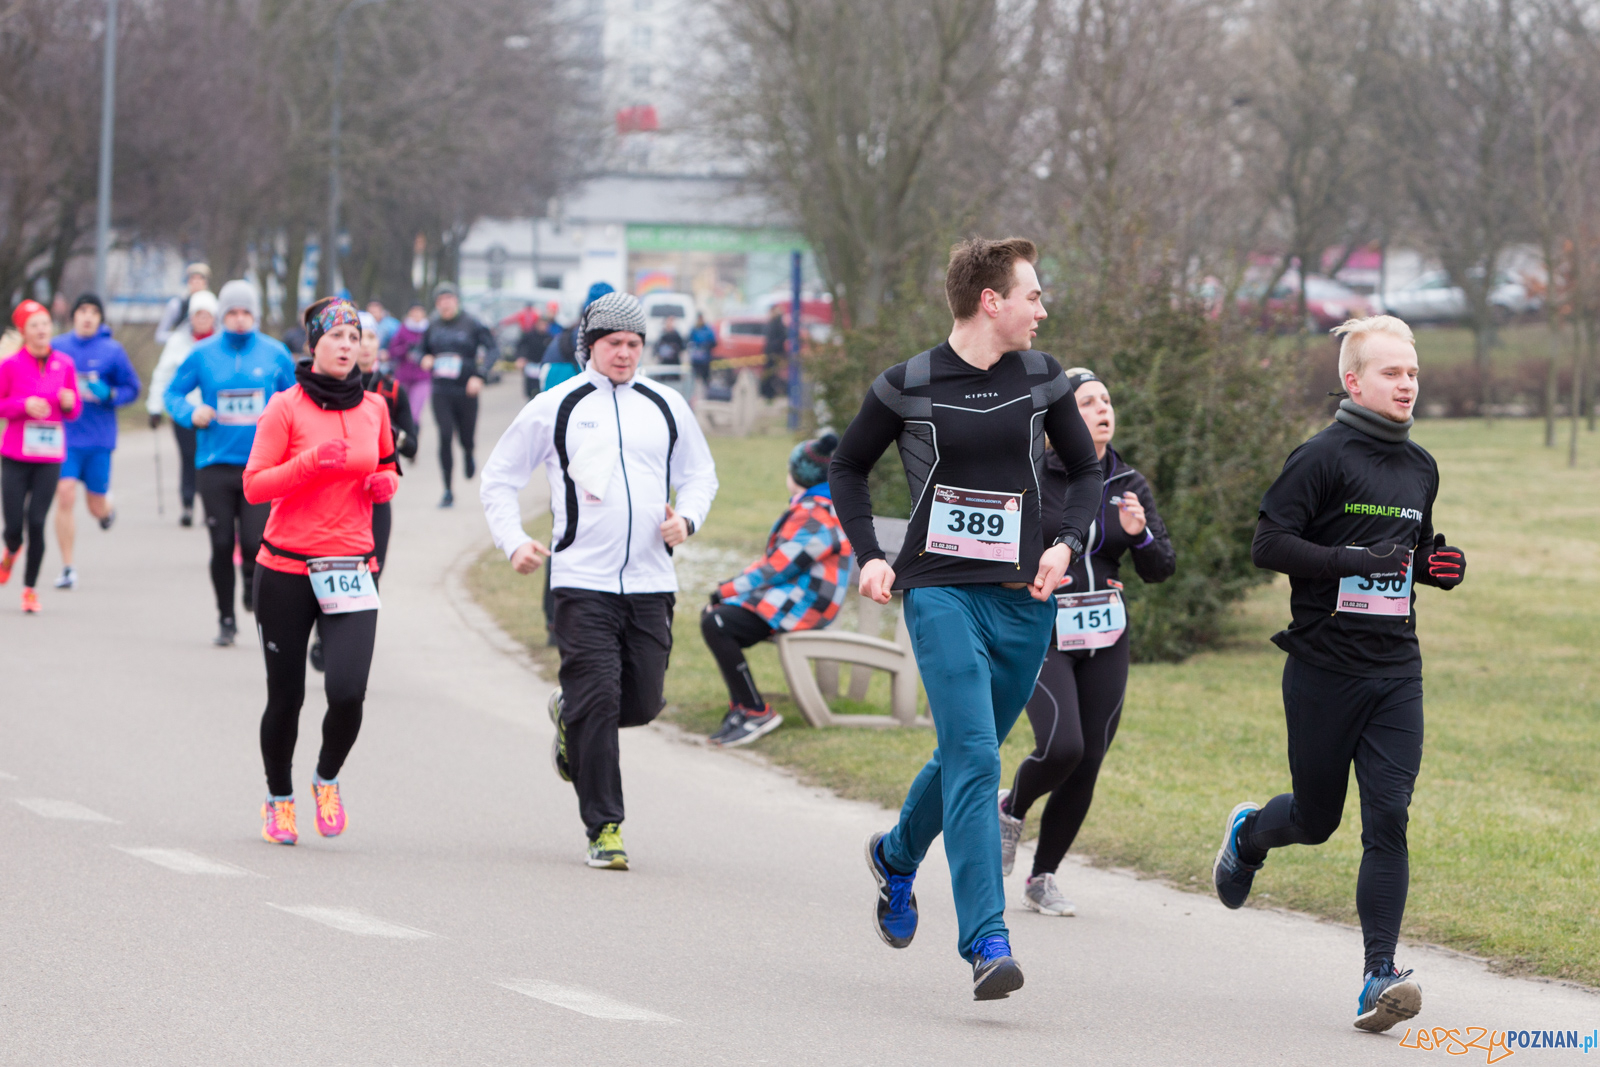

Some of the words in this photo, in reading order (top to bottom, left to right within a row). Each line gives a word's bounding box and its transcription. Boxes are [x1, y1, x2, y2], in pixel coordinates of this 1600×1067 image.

[947, 509, 1004, 537] 389
[324, 574, 362, 593] 164
[1073, 608, 1111, 630] 151
